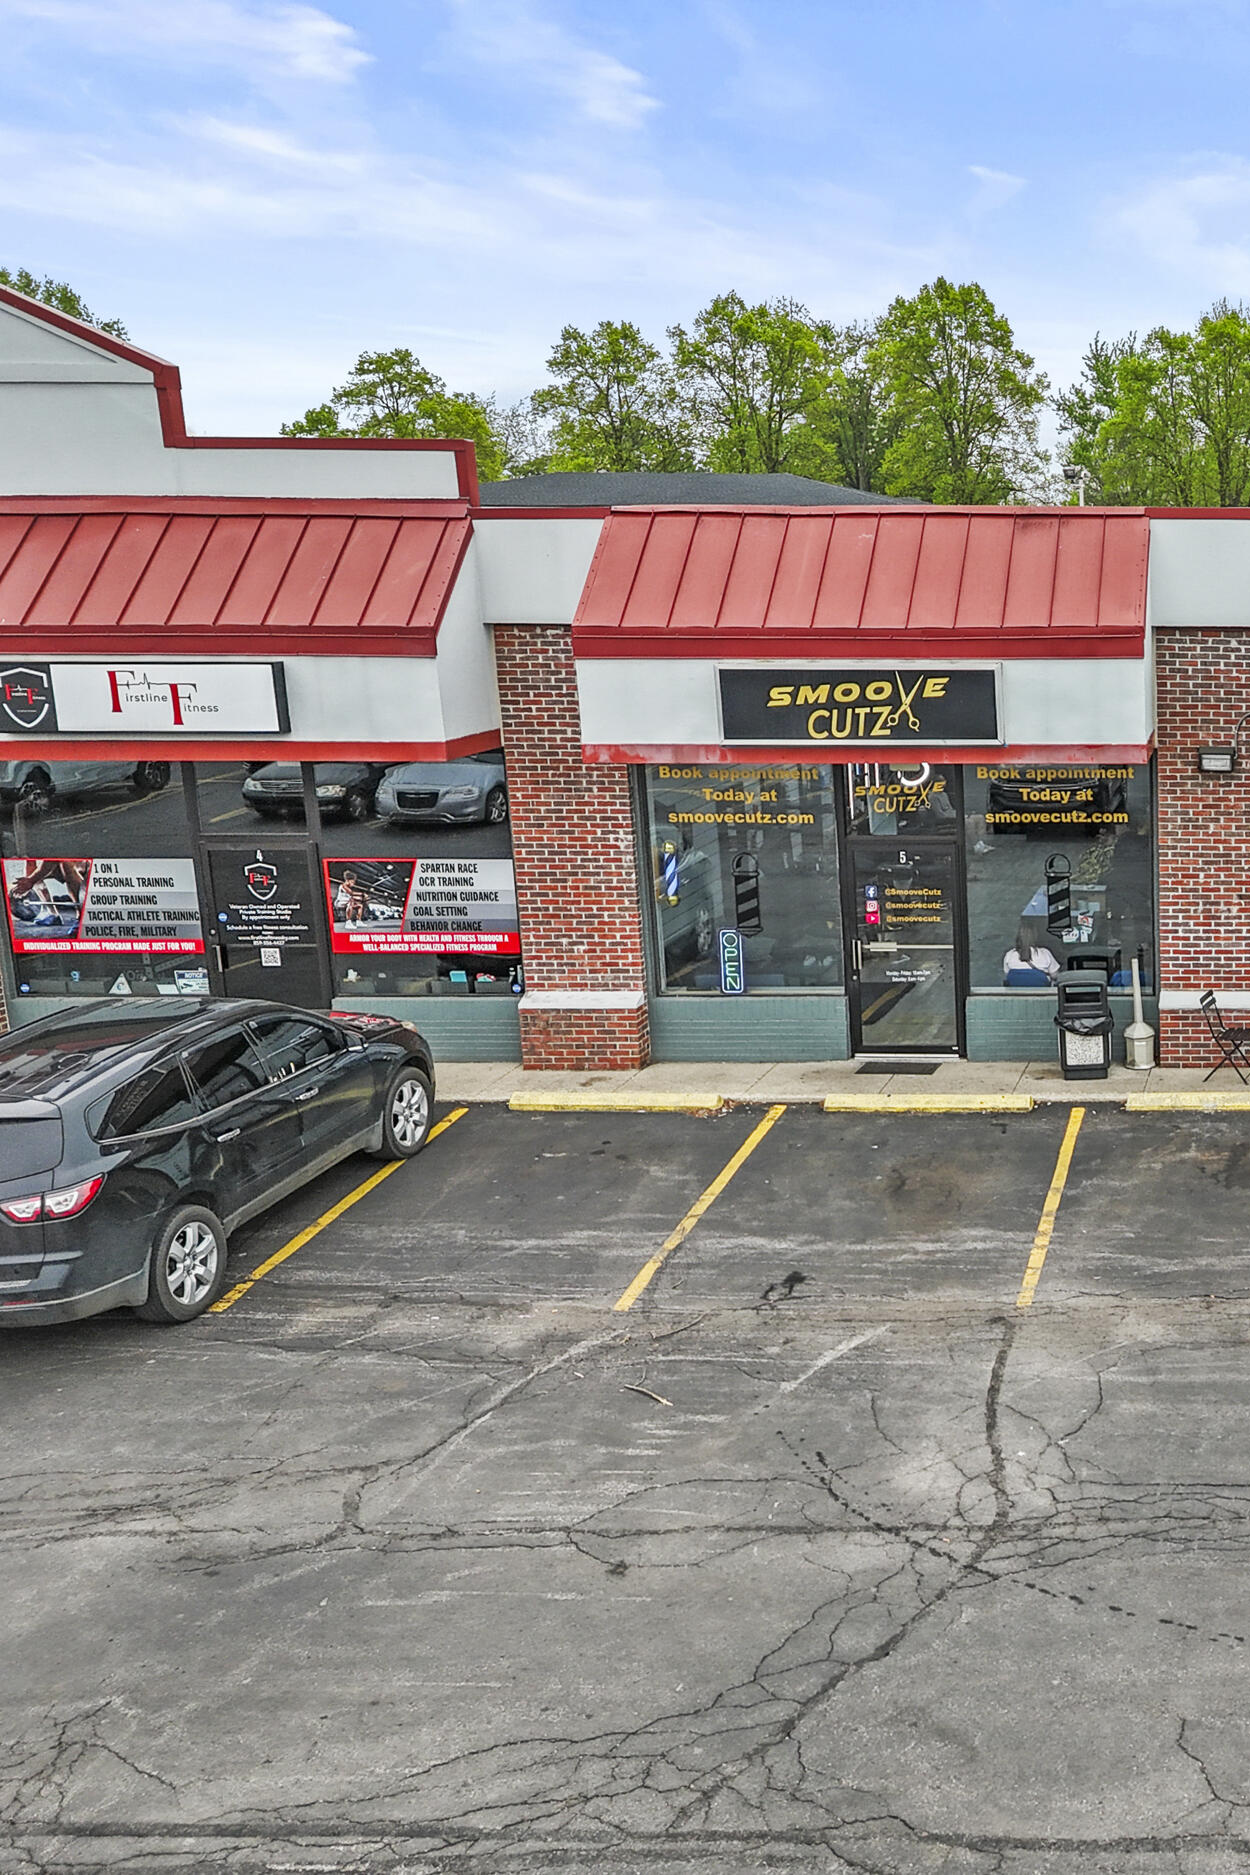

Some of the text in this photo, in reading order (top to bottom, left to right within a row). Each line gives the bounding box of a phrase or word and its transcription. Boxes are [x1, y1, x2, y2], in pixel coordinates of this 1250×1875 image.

[766, 673, 950, 708] SMOOVE
[807, 706, 892, 739] CUTZ
[659, 766, 819, 781] Book appointment
[976, 766, 1134, 782] Book appointment
[702, 788, 778, 803] Today at
[1019, 788, 1093, 803] Today at
[874, 796, 917, 813] CUTZ
[668, 812, 814, 824] smoovecutz.com
[985, 811, 1128, 823] smoovecutz.com
[256, 850, 263, 862] 4
[900, 851, 906, 863] 5
[94, 864, 119, 873] 1 ON 1
[420, 864, 478, 873] SPARTAN RACE
[93, 877, 174, 887] PERSONAL TRAINING
[419, 877, 474, 886] OCR TRAINING
[91, 895, 157, 905] GROUP TRAINING
[416, 892, 499, 901] NUTRITION GUIDANCE
[88, 911, 200, 921] TACTICAL ATHLETE TRAINING
[413, 906, 468, 916] GOAL SETTING
[86, 926, 177, 937] POLICE, FIRE, MILITARY
[410, 921, 482, 931] BEHAVIOR CHANGE
[350, 934, 509, 942] ARMOR YOUR BODY WITH HEALTH AND FITNESS THROUGH A
[23, 942, 195, 950] INDIVIDUALIZED TRAINING PROGRAM MADE JUST FOR YOU!
[723, 933, 740, 990] OPEN
